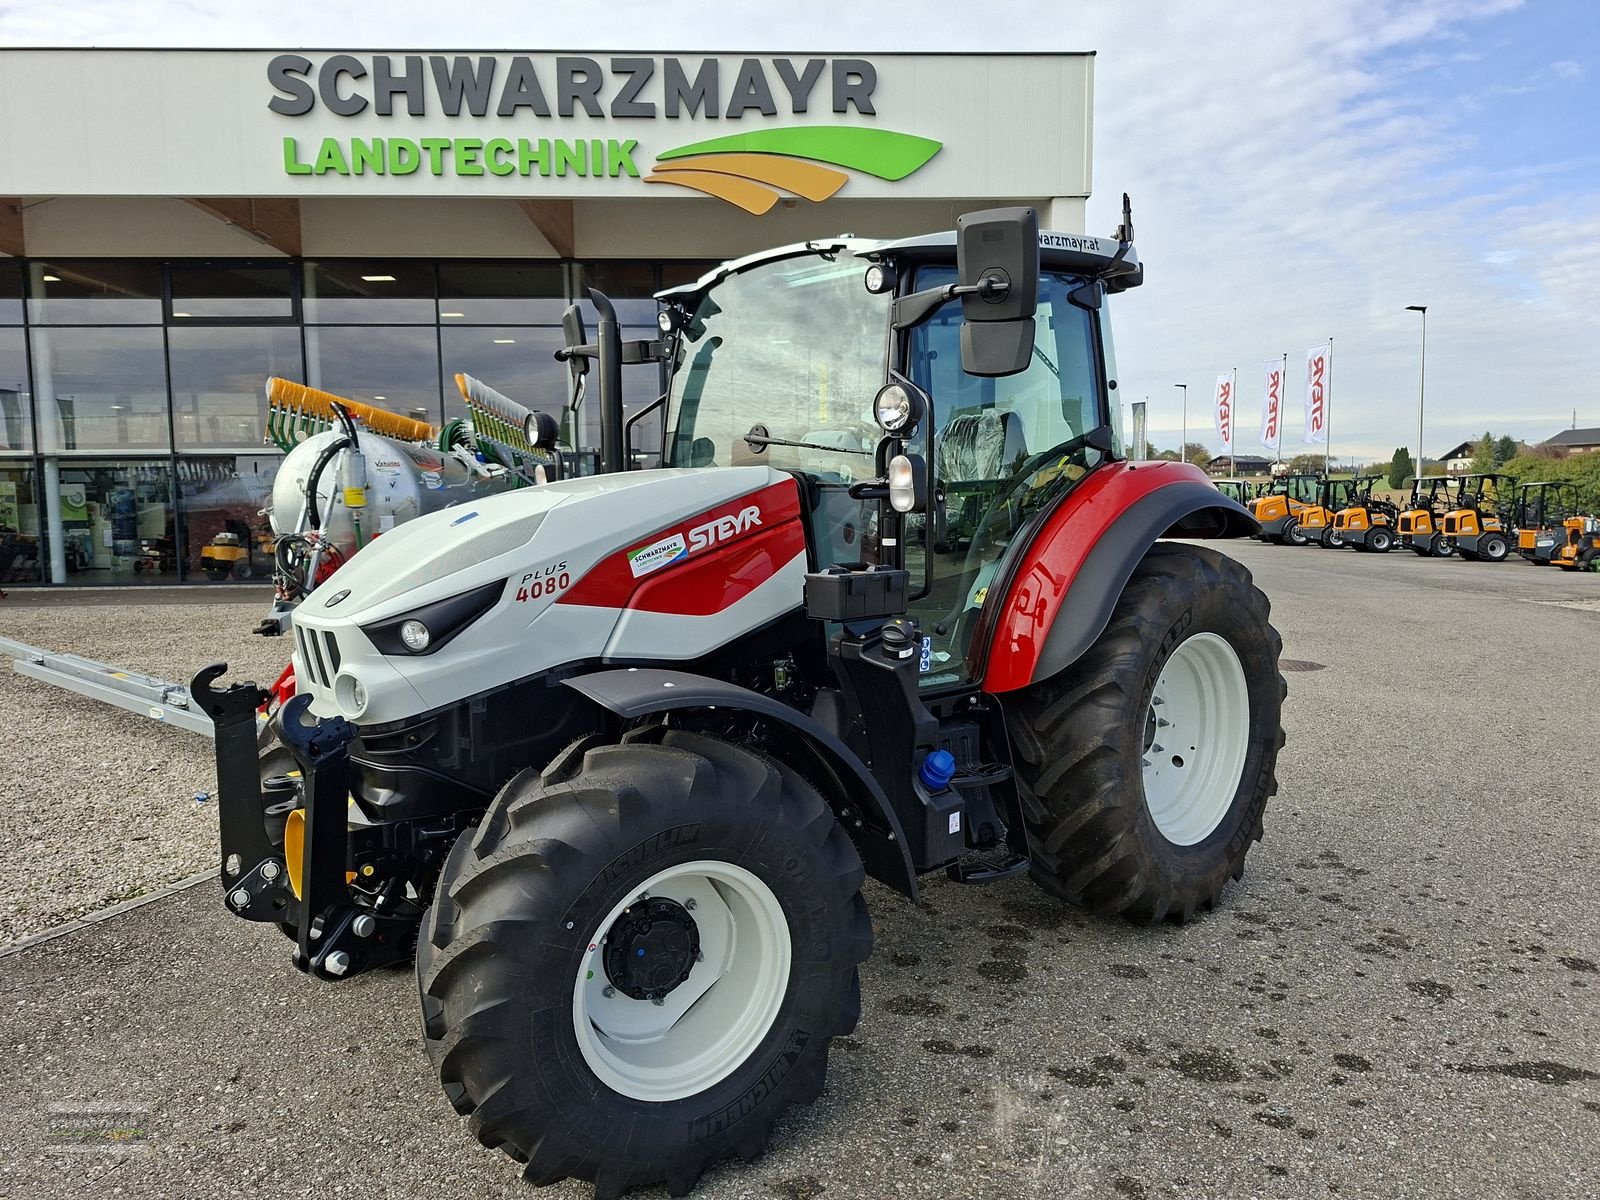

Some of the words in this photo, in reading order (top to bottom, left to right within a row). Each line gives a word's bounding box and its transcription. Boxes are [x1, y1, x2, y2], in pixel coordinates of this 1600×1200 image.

[267, 54, 877, 120] SCHWARZMAYR
[283, 136, 640, 178] LANDTECHNIK
[688, 505, 763, 553] STEYR
[634, 541, 677, 563] SCHWARZMAYR
[515, 572, 570, 603] 4080
[521, 560, 568, 585] PLUS
